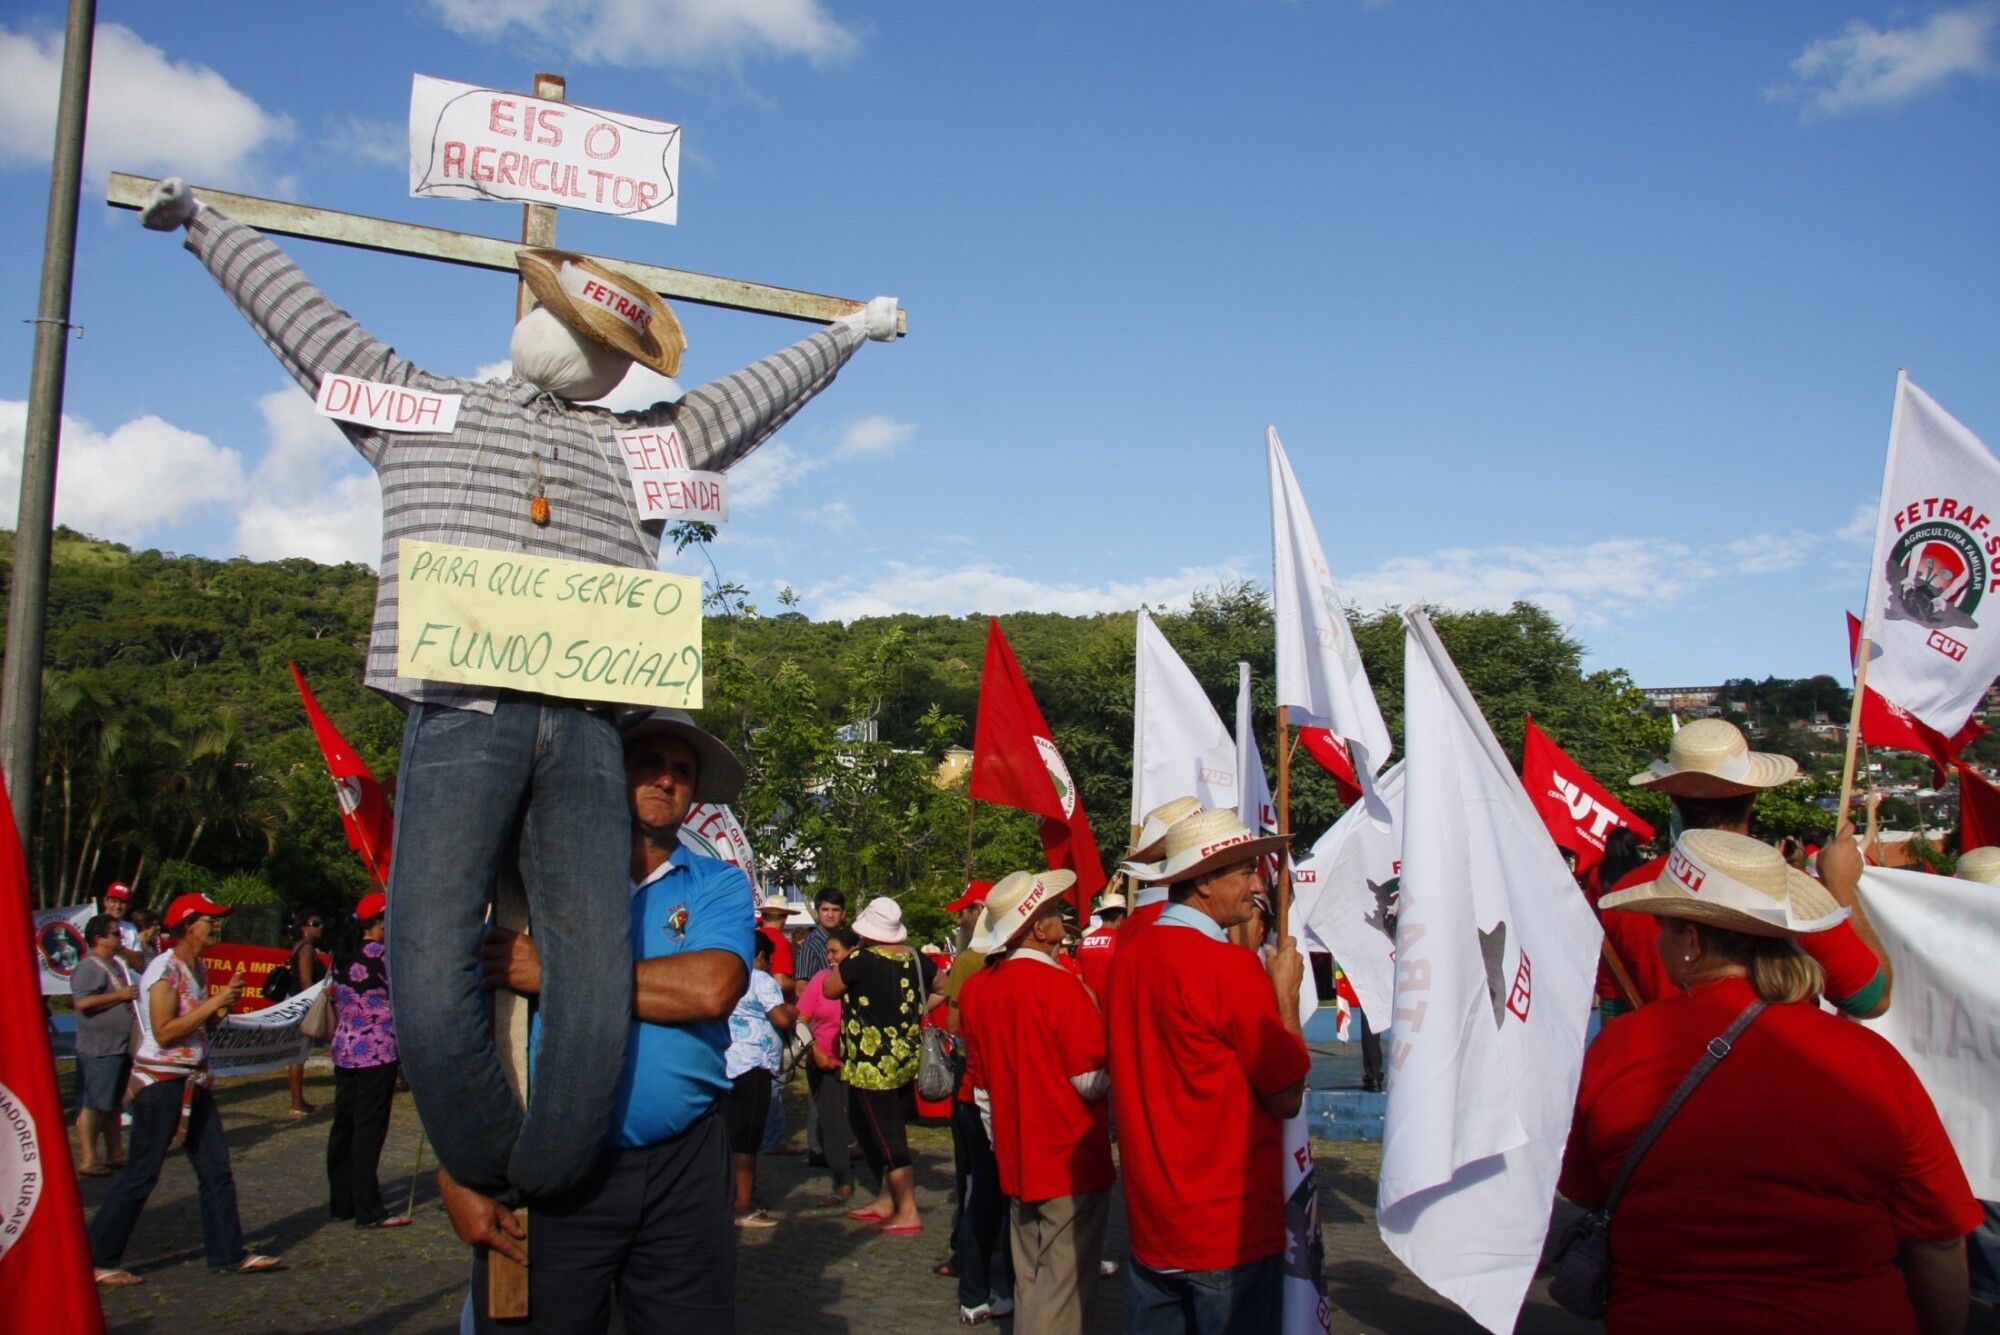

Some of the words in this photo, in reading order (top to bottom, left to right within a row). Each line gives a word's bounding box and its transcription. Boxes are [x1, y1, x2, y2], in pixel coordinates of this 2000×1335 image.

[489, 99, 568, 147] EIS
[584, 122, 621, 160] O
[443, 141, 658, 211] AGRICULTOR
[621, 432, 684, 470] SEM
[643, 480, 720, 512] RENDA
[1904, 527, 1966, 549] AGRICULTURA
[1963, 543, 1982, 590] FAMILIAR
[410, 551, 479, 588] PARA
[488, 562, 550, 598] QUE
[557, 572, 653, 608] SERVE
[654, 583, 682, 615] O
[410, 622, 552, 675] FUNDO
[1929, 632, 1966, 661] CUT
[731, 828, 745, 848] CUT
[1671, 853, 1705, 889] CUT
[1083, 937, 1109, 946] CUT
[5, 1171, 37, 1235] RURAIS
